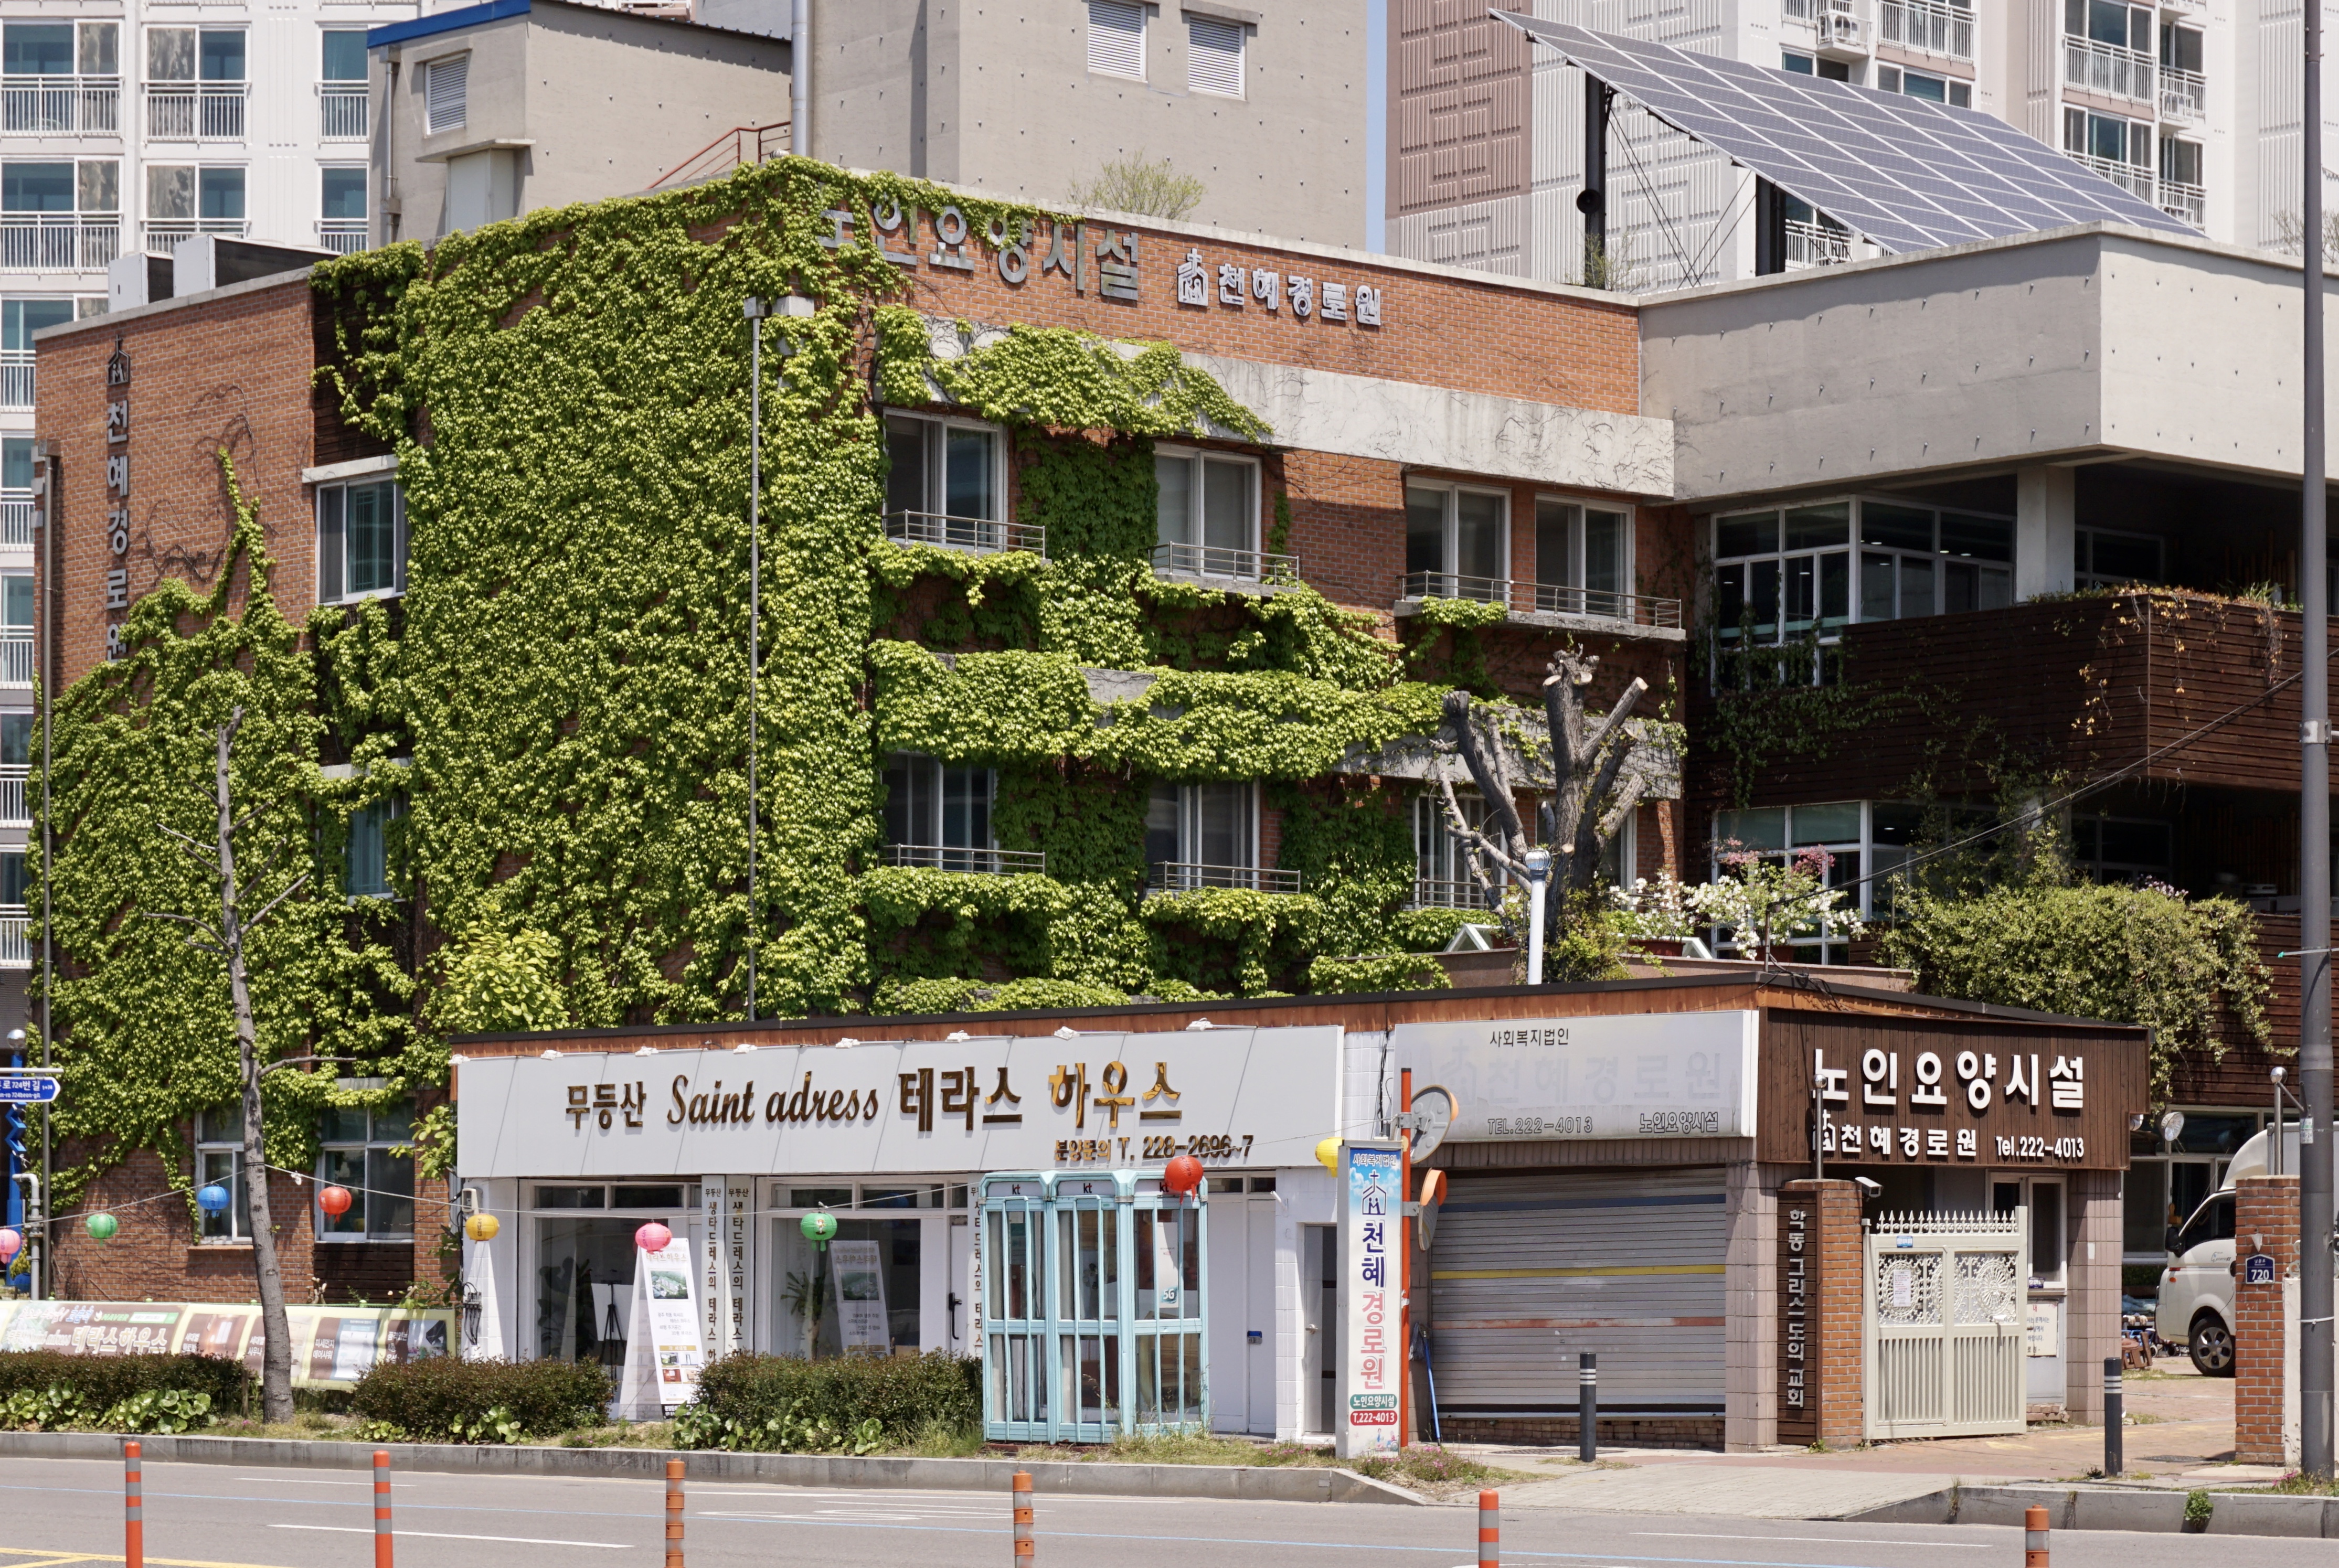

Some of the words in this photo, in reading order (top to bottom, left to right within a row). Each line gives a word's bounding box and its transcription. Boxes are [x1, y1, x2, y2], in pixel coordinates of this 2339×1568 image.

[1218, 264, 1381, 326] 천혜경로원
[1490, 1028, 1569, 1047] 사회복지법인
[1486, 1051, 1721, 1105] 천혜경로원
[1812, 1048, 2083, 1110] 노인요양시설
[566, 1081, 647, 1130] 무등산
[667, 1074, 754, 1124] Saint
[765, 1071, 879, 1123] adress
[899, 1066, 1023, 1132] 테라스
[1048, 1061, 1183, 1129] 하우스
[1639, 1111, 1719, 1134] 노인요양시설
[1841, 1124, 1977, 1157] 천혜경로원
[1996, 1135, 2085, 1158] Tel.222-4013
[1054, 1139, 1111, 1161] 분양문의
[1353, 1153, 1397, 1166] 사회복지법인
[705, 1188, 721, 1197] 무등산
[728, 1188, 749, 1197] 무등산
[1012, 1183, 1020, 1195] kt
[1083, 1182, 1092, 1194] kt
[1159, 1182, 1169, 1193] kt
[2251, 1270, 2269, 1280] 720
[1163, 1289, 1175, 1301] 5G
[1360, 1222, 1386, 1390] 천혜경로원
[102, 1313, 130, 1321] NAVER
[315, 1338, 335, 1349] 미세먼지
[1353, 1395, 1395, 1407] 노인요양시설
[1352, 1412, 1395, 1424] T.222-4013
